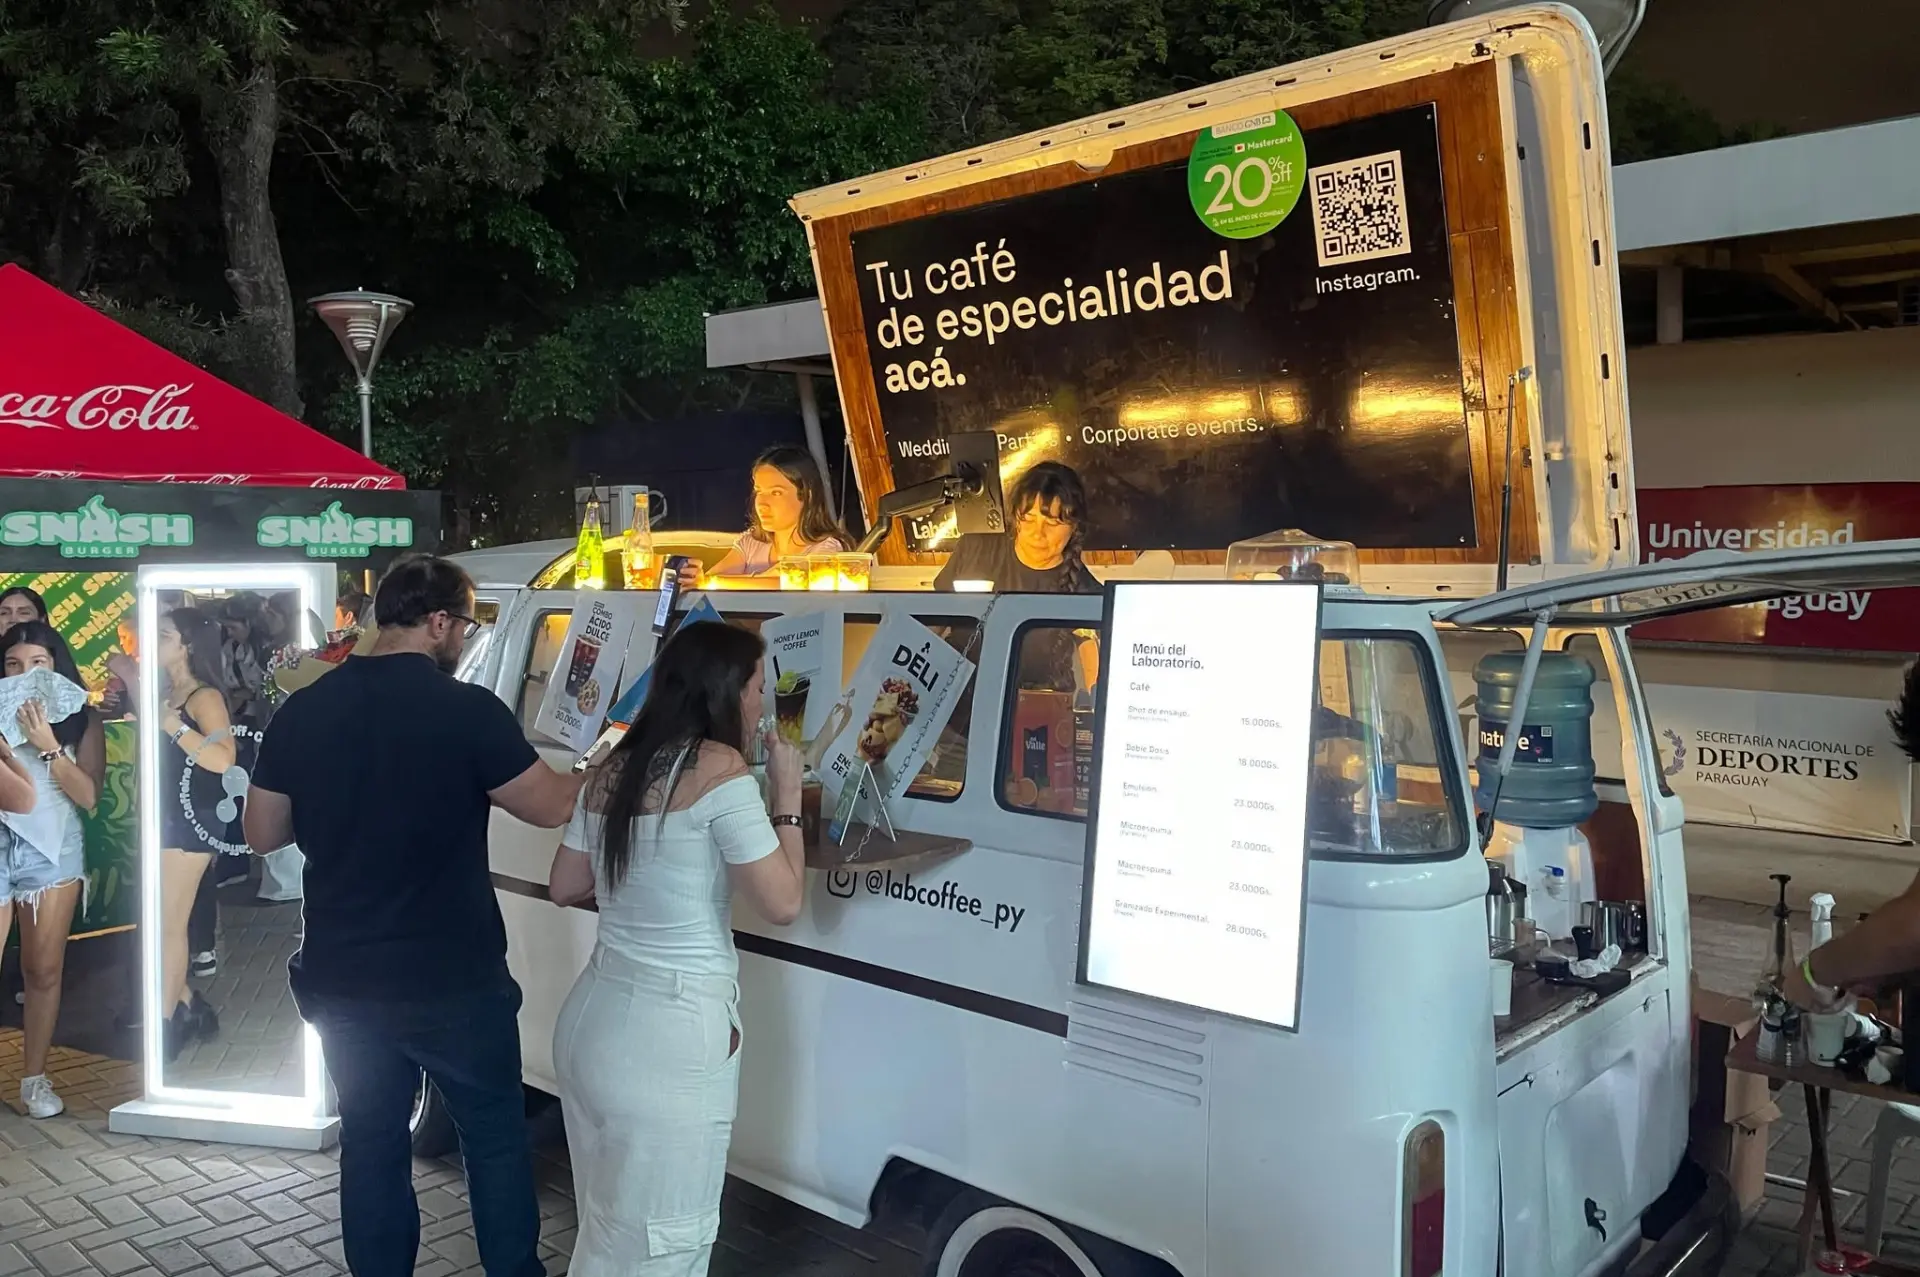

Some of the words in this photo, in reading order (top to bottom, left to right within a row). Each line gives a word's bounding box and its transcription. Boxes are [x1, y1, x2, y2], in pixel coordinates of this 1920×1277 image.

[1247, 132, 1293, 150] Mastercard
[1203, 157, 1272, 216] 20
[1271, 162, 1293, 184] off
[867, 260, 913, 303] Tu
[924, 238, 1017, 295] café
[1315, 267, 1420, 294] Instagram.
[877, 307, 924, 350] de
[936, 249, 1233, 345] especialidad
[884, 346, 967, 394] acá.
[1081, 423, 1179, 447] Corporate
[1186, 416, 1265, 437] events.
[2, 500, 192, 544] SNASH
[259, 506, 411, 544] SNASH
[1648, 521, 1854, 550] Universidad
[65, 545, 136, 555] BURGER
[310, 546, 367, 555] BURGER
[592, 606, 613, 620] COMBO
[585, 624, 611, 643] DULCE
[773, 633, 796, 645] HONEY
[796, 629, 820, 641] LEMON
[783, 640, 808, 652] COFFEE
[1132, 643, 1165, 656] Menú
[1167, 644, 1187, 656] del
[1131, 655, 1205, 670] Laboratorio.
[1129, 682, 1151, 692] Café
[1127, 705, 1146, 714] Shot
[1147, 707, 1158, 715] de
[1480, 730, 1530, 751] nate
[1696, 731, 1774, 748] SECRETARÍA
[1777, 738, 1853, 756] NACIONAL
[1855, 744, 1875, 757] DE
[1697, 747, 1859, 781] DEPORTES
[1696, 771, 1769, 787] PARAGUAY
[865, 869, 1026, 933] @labcoffee_py
